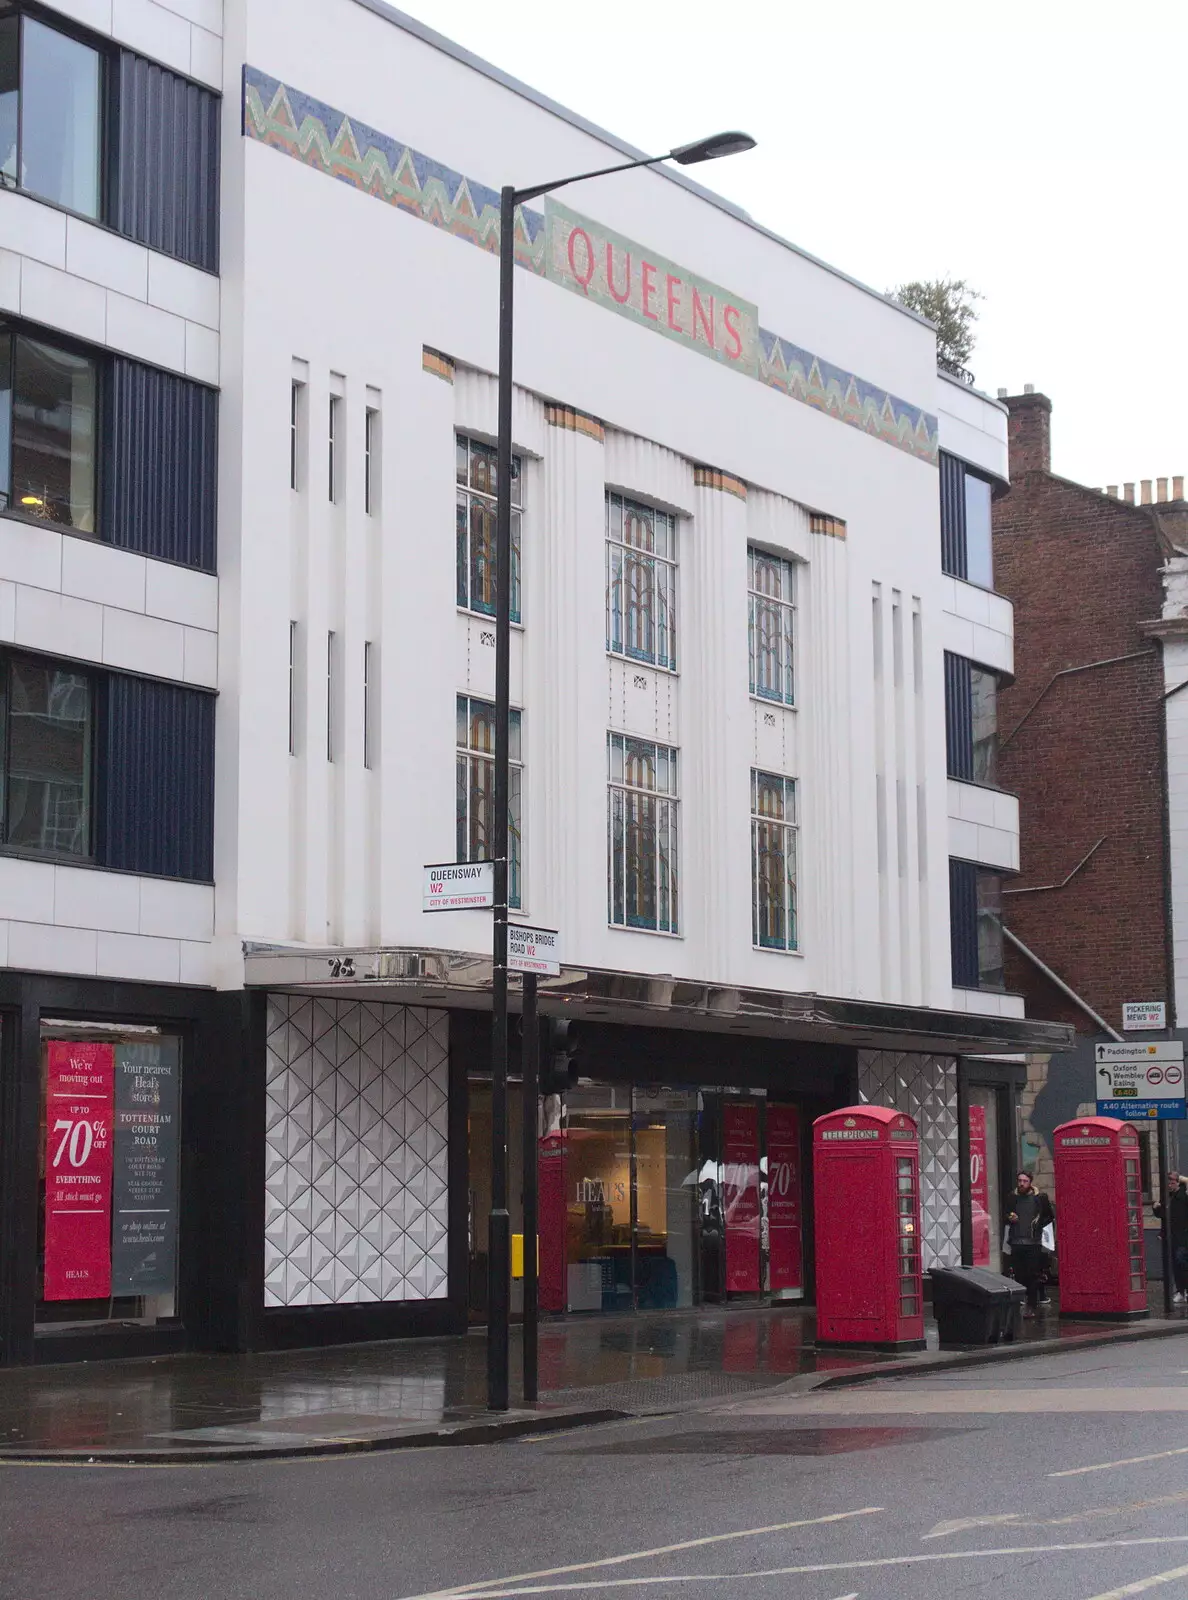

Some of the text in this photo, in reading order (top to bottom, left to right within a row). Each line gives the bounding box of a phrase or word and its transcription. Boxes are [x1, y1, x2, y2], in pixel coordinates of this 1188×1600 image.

[568, 227, 743, 360] QUEENS
[430, 867, 482, 881] QUEENSWAY
[430, 883, 443, 894] W2
[429, 896, 487, 907] CITY OF WESTMINSTER
[510, 929, 555, 947] BISHOPS BRIDGE
[510, 942, 536, 956] ROAD W2
[1126, 1005, 1162, 1013] PICKERING
[1126, 1013, 1160, 1021] MEWS W2
[1107, 1047, 1146, 1056] Paddington
[70, 1059, 93, 1070] We're
[122, 1060, 172, 1076] Your nearest
[59, 1071, 103, 1087] moving out
[1113, 1072, 1145, 1080] Wembley
[135, 1075, 160, 1090] Heal's
[80, 1106, 90, 1114] TO
[1120, 1102, 1158, 1110] Alternative
[120, 1113, 172, 1124] TOTTENHAM
[131, 1126, 161, 1135] COURT
[824, 1130, 877, 1140] TELEPHONE
[93, 1140, 107, 1149] OFF
[134, 1136, 158, 1145] ROAD
[55, 1175, 102, 1184] EVERYTHING
